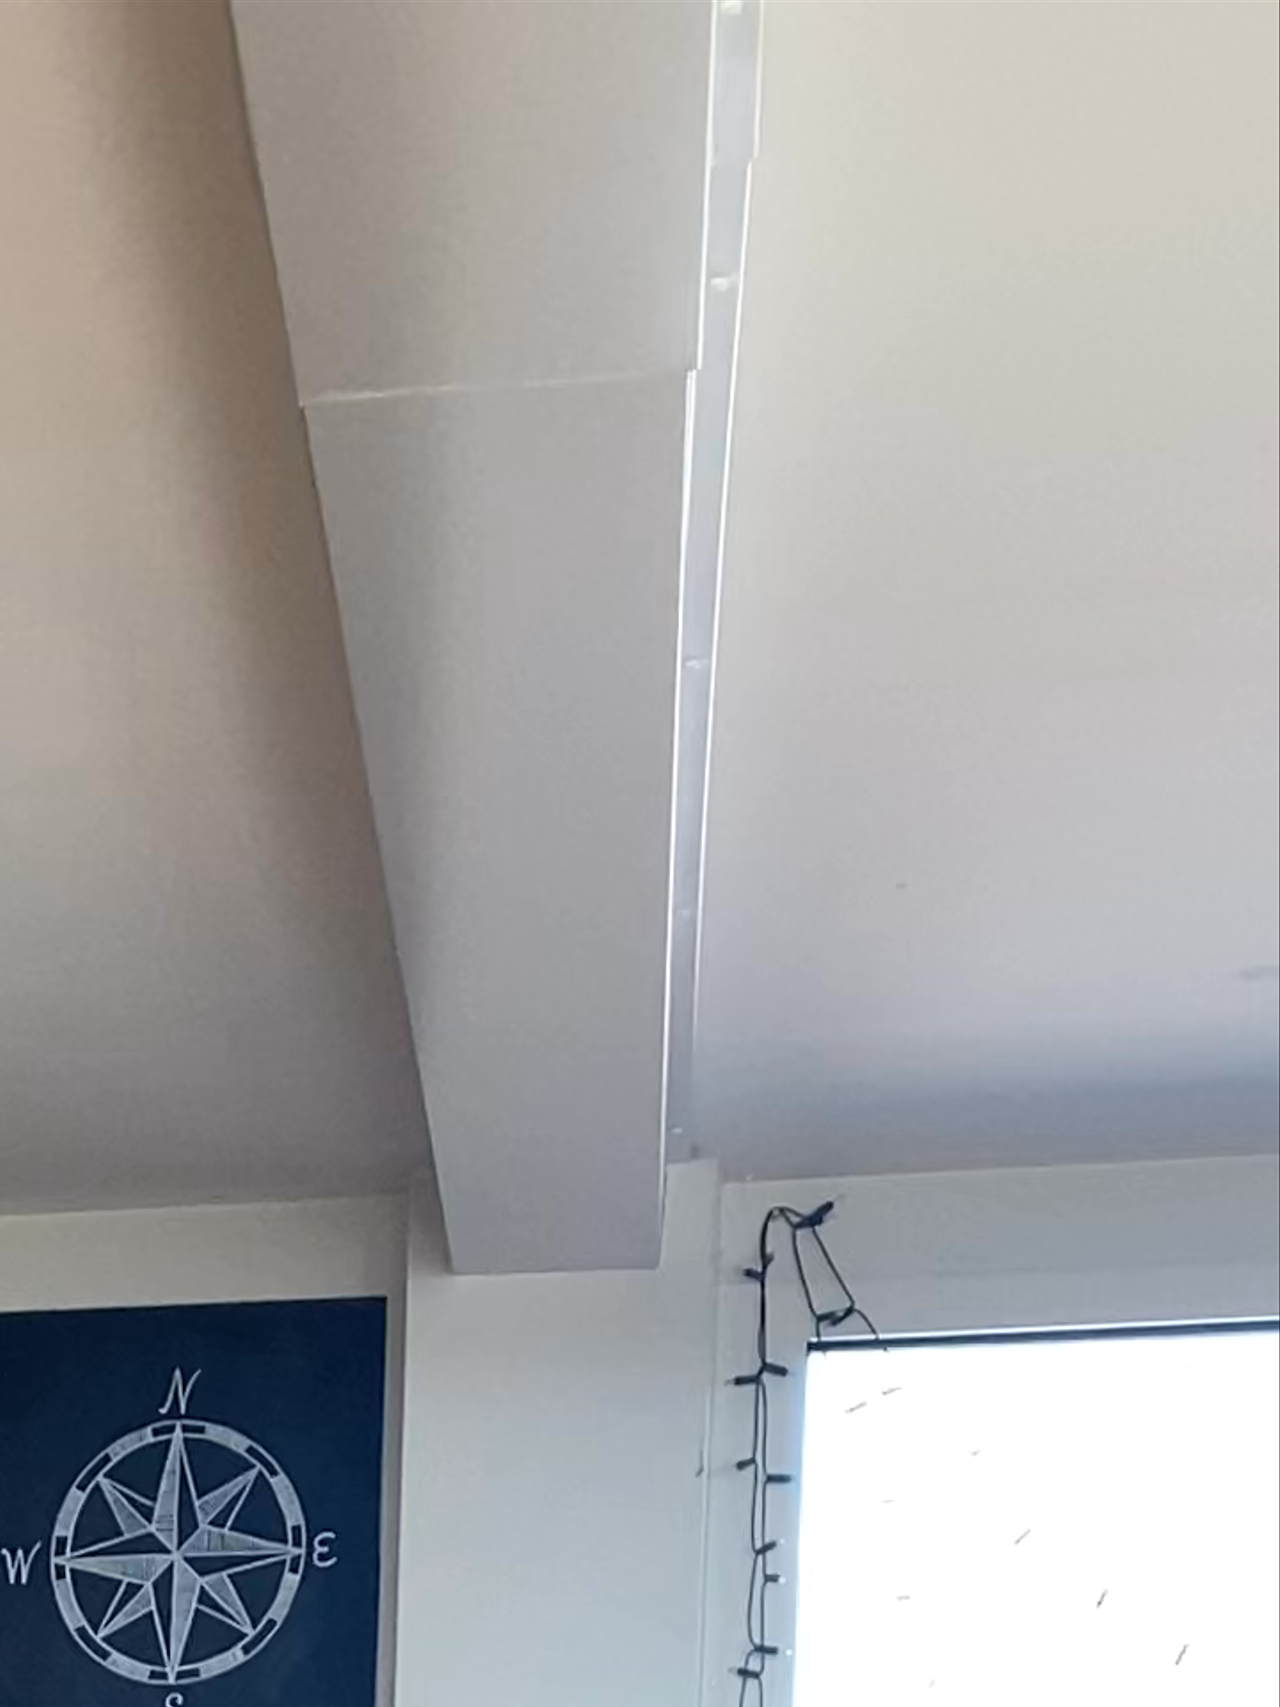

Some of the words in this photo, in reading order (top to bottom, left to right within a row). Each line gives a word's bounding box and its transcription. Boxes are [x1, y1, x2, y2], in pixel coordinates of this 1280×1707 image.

[157, 1367, 202, 1415] N
[0, 1541, 42, 1585] W
[312, 1531, 338, 1568] E
